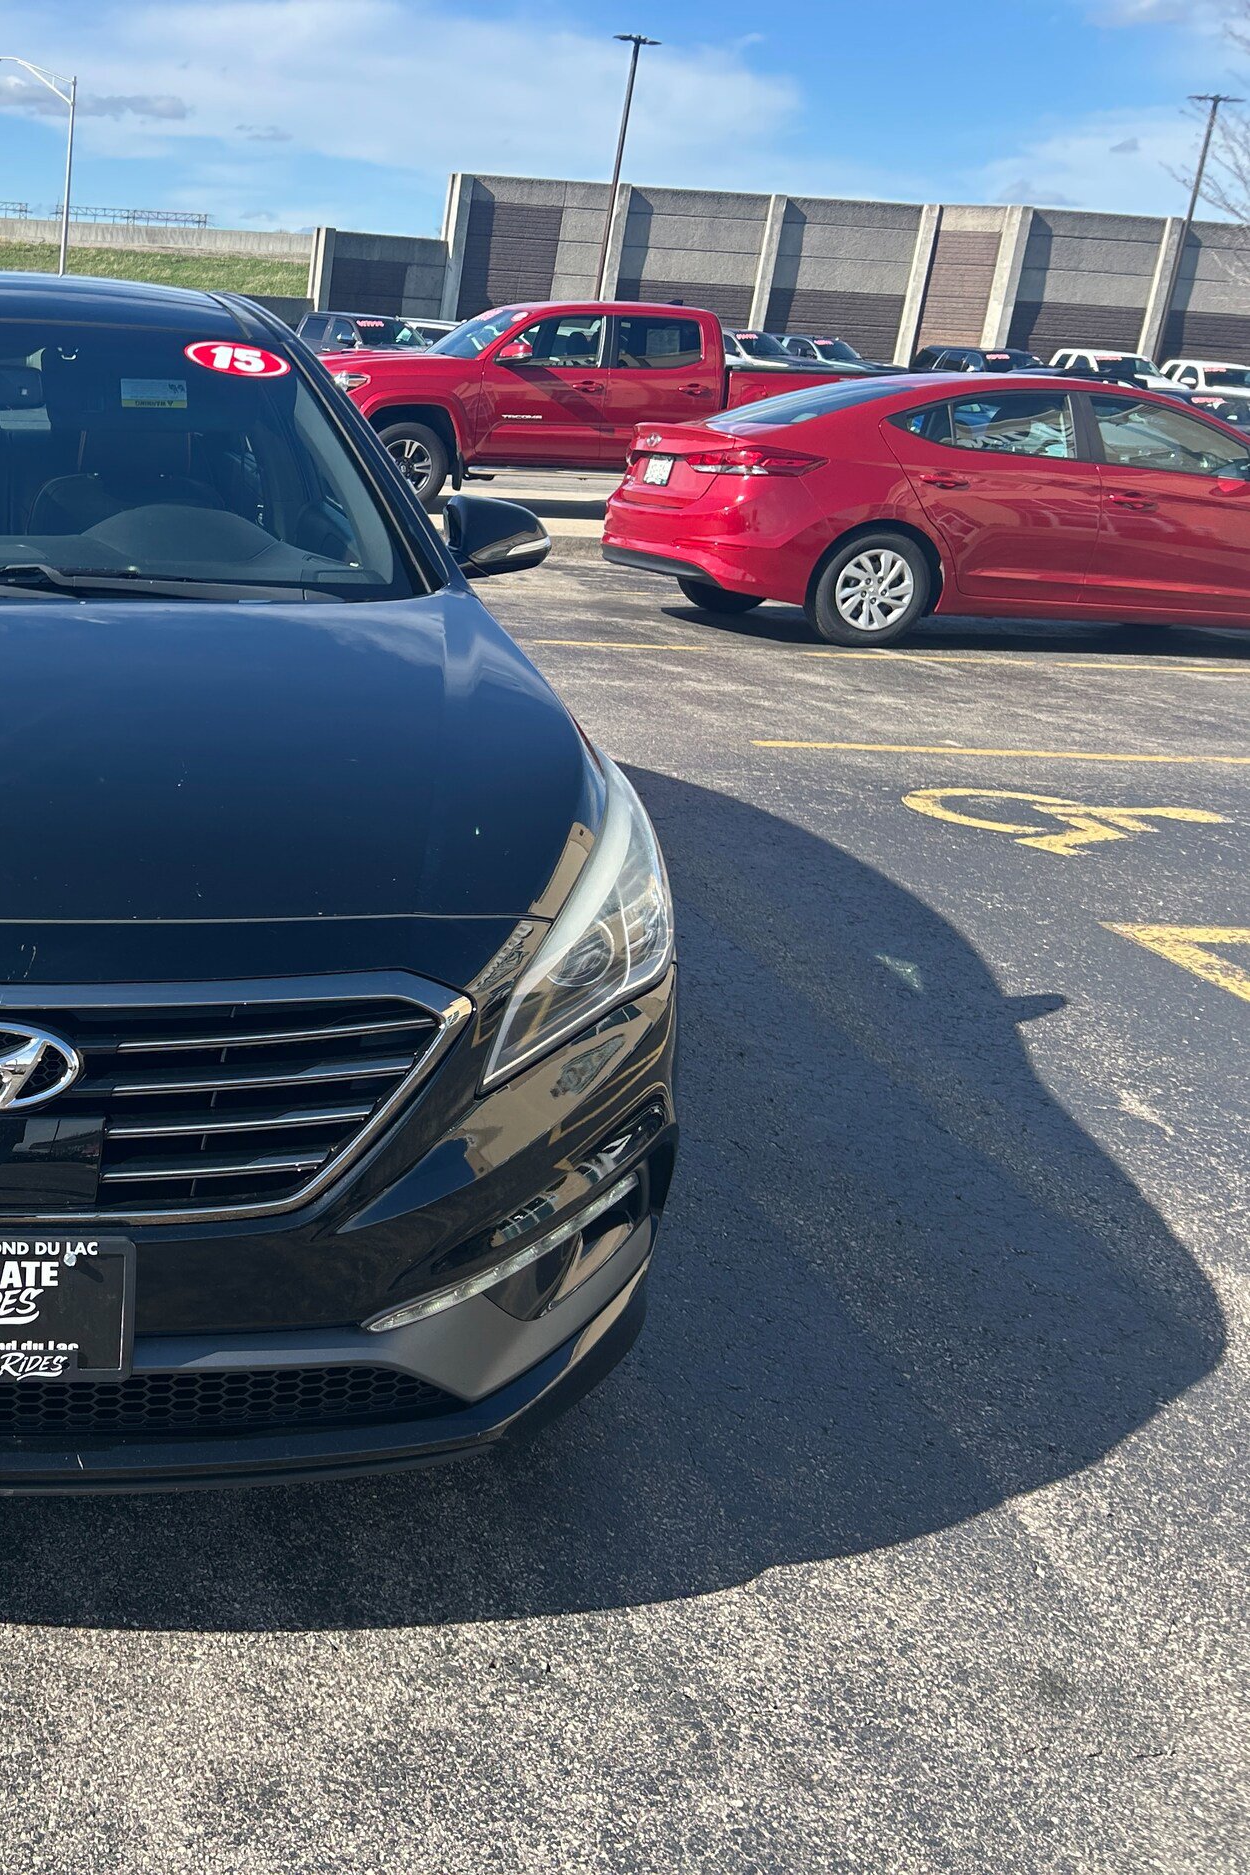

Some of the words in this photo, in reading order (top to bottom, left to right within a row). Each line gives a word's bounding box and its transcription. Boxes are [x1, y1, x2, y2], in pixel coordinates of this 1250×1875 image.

[210, 345, 266, 373] 15
[35, 1241, 60, 1256] DU
[65, 1241, 98, 1256] LAC
